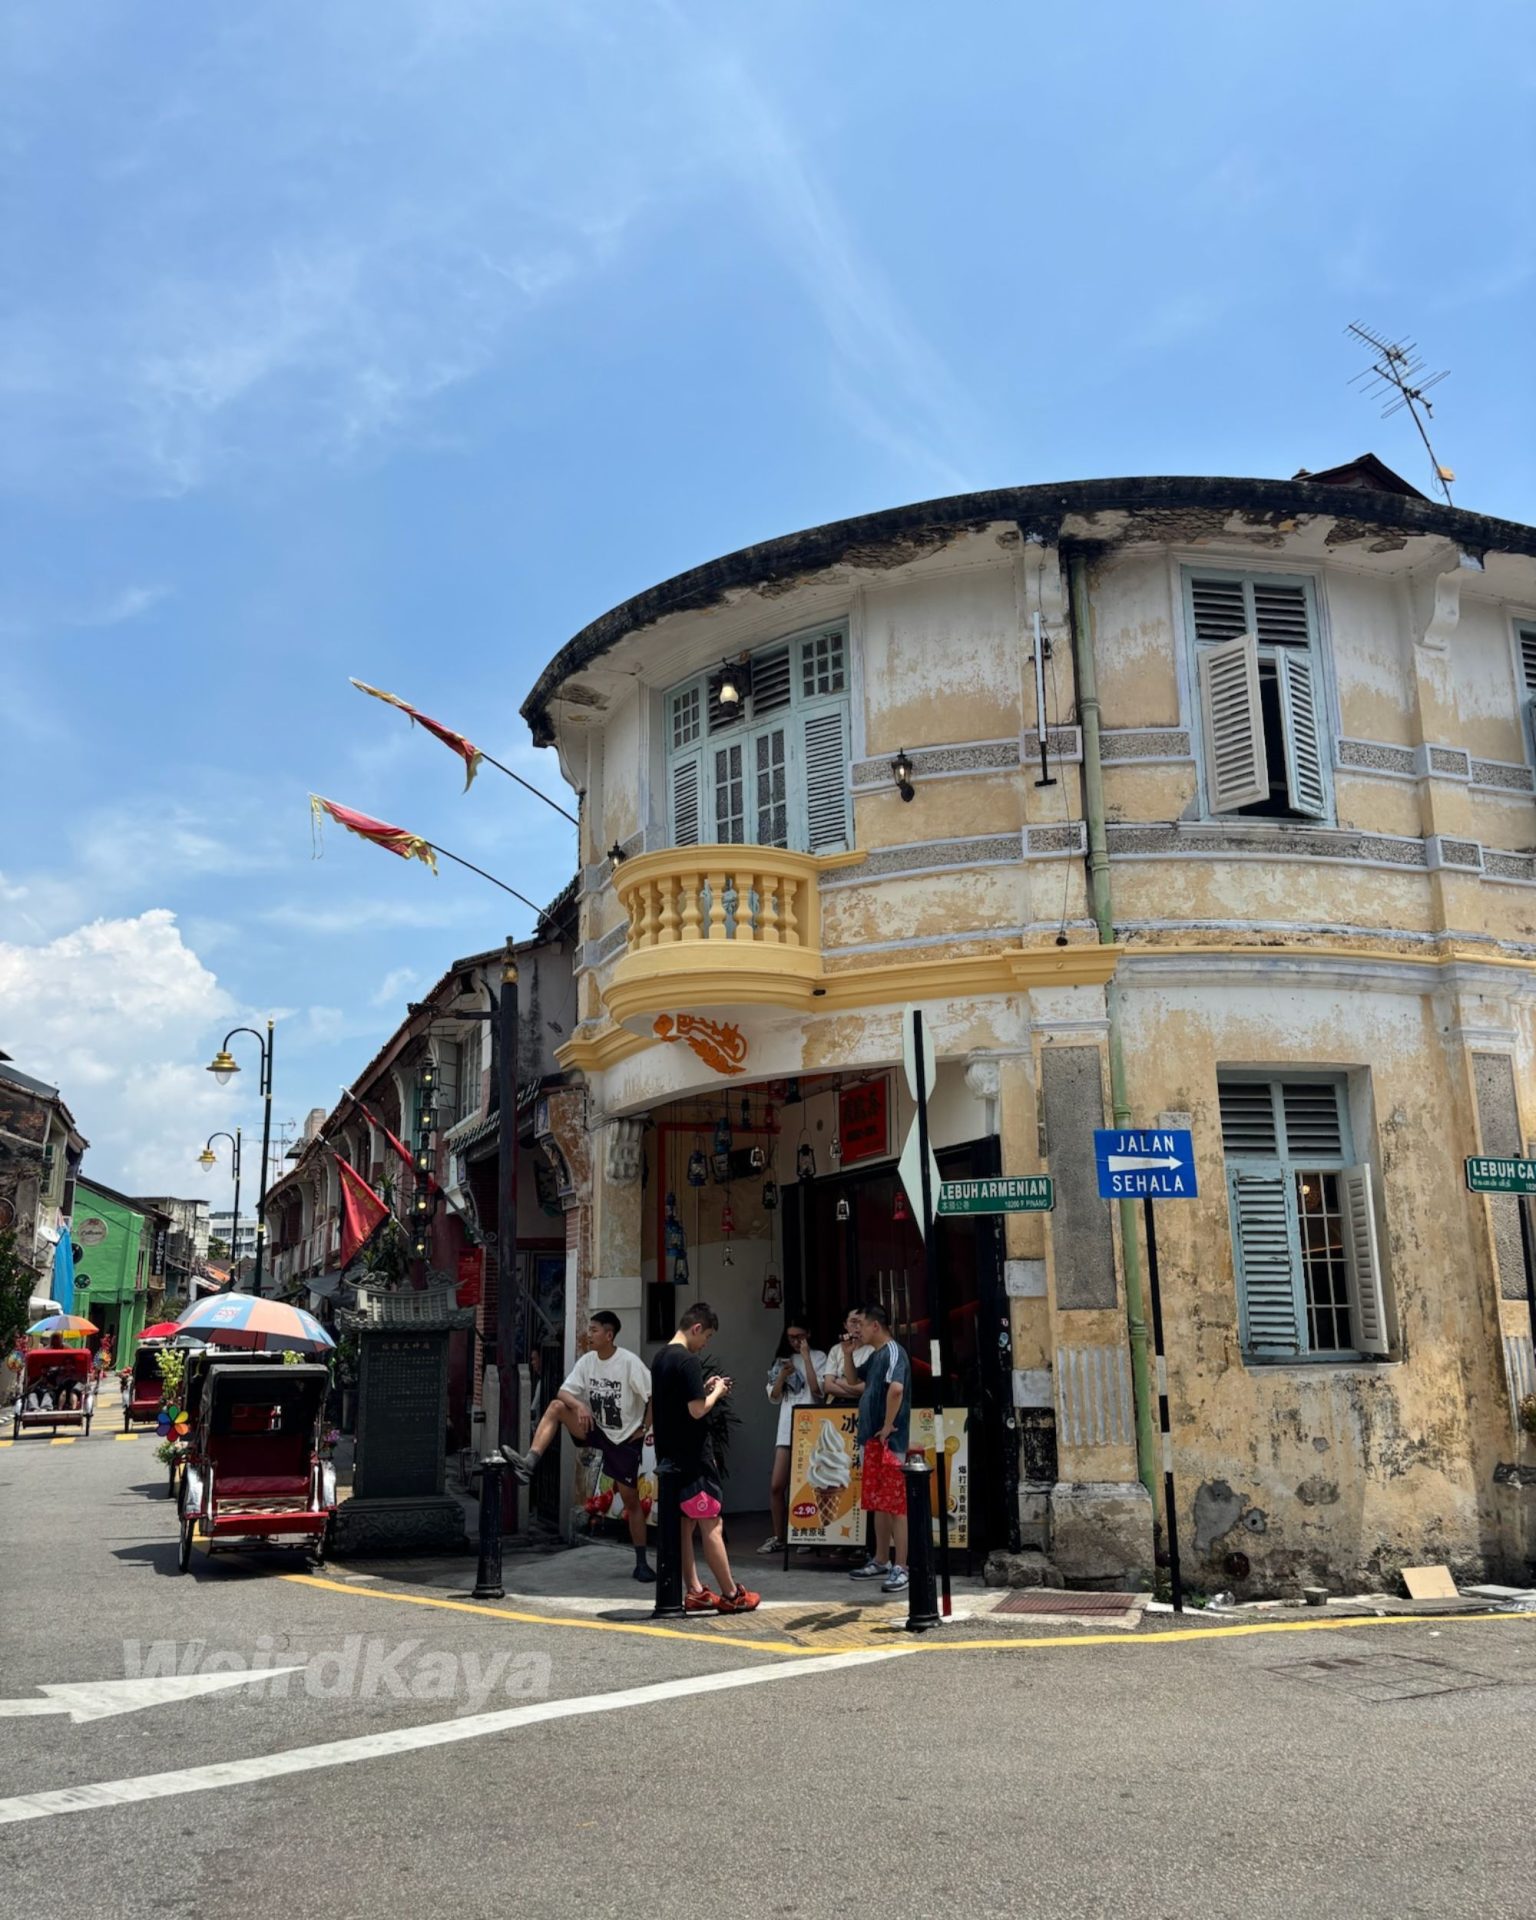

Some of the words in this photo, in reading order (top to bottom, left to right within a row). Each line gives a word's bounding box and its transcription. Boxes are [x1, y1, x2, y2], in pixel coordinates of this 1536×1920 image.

[1116, 1135, 1175, 1152] JALAN
[1472, 1161, 1516, 1178] LEBUH
[1517, 1163, 1536, 1179] CA
[941, 1183, 979, 1200] LEBUH
[981, 1180, 1047, 1198] ARMENIAN
[1112, 1174, 1185, 1192] SEHALA
[1025, 1199, 1048, 1208] PINANG
